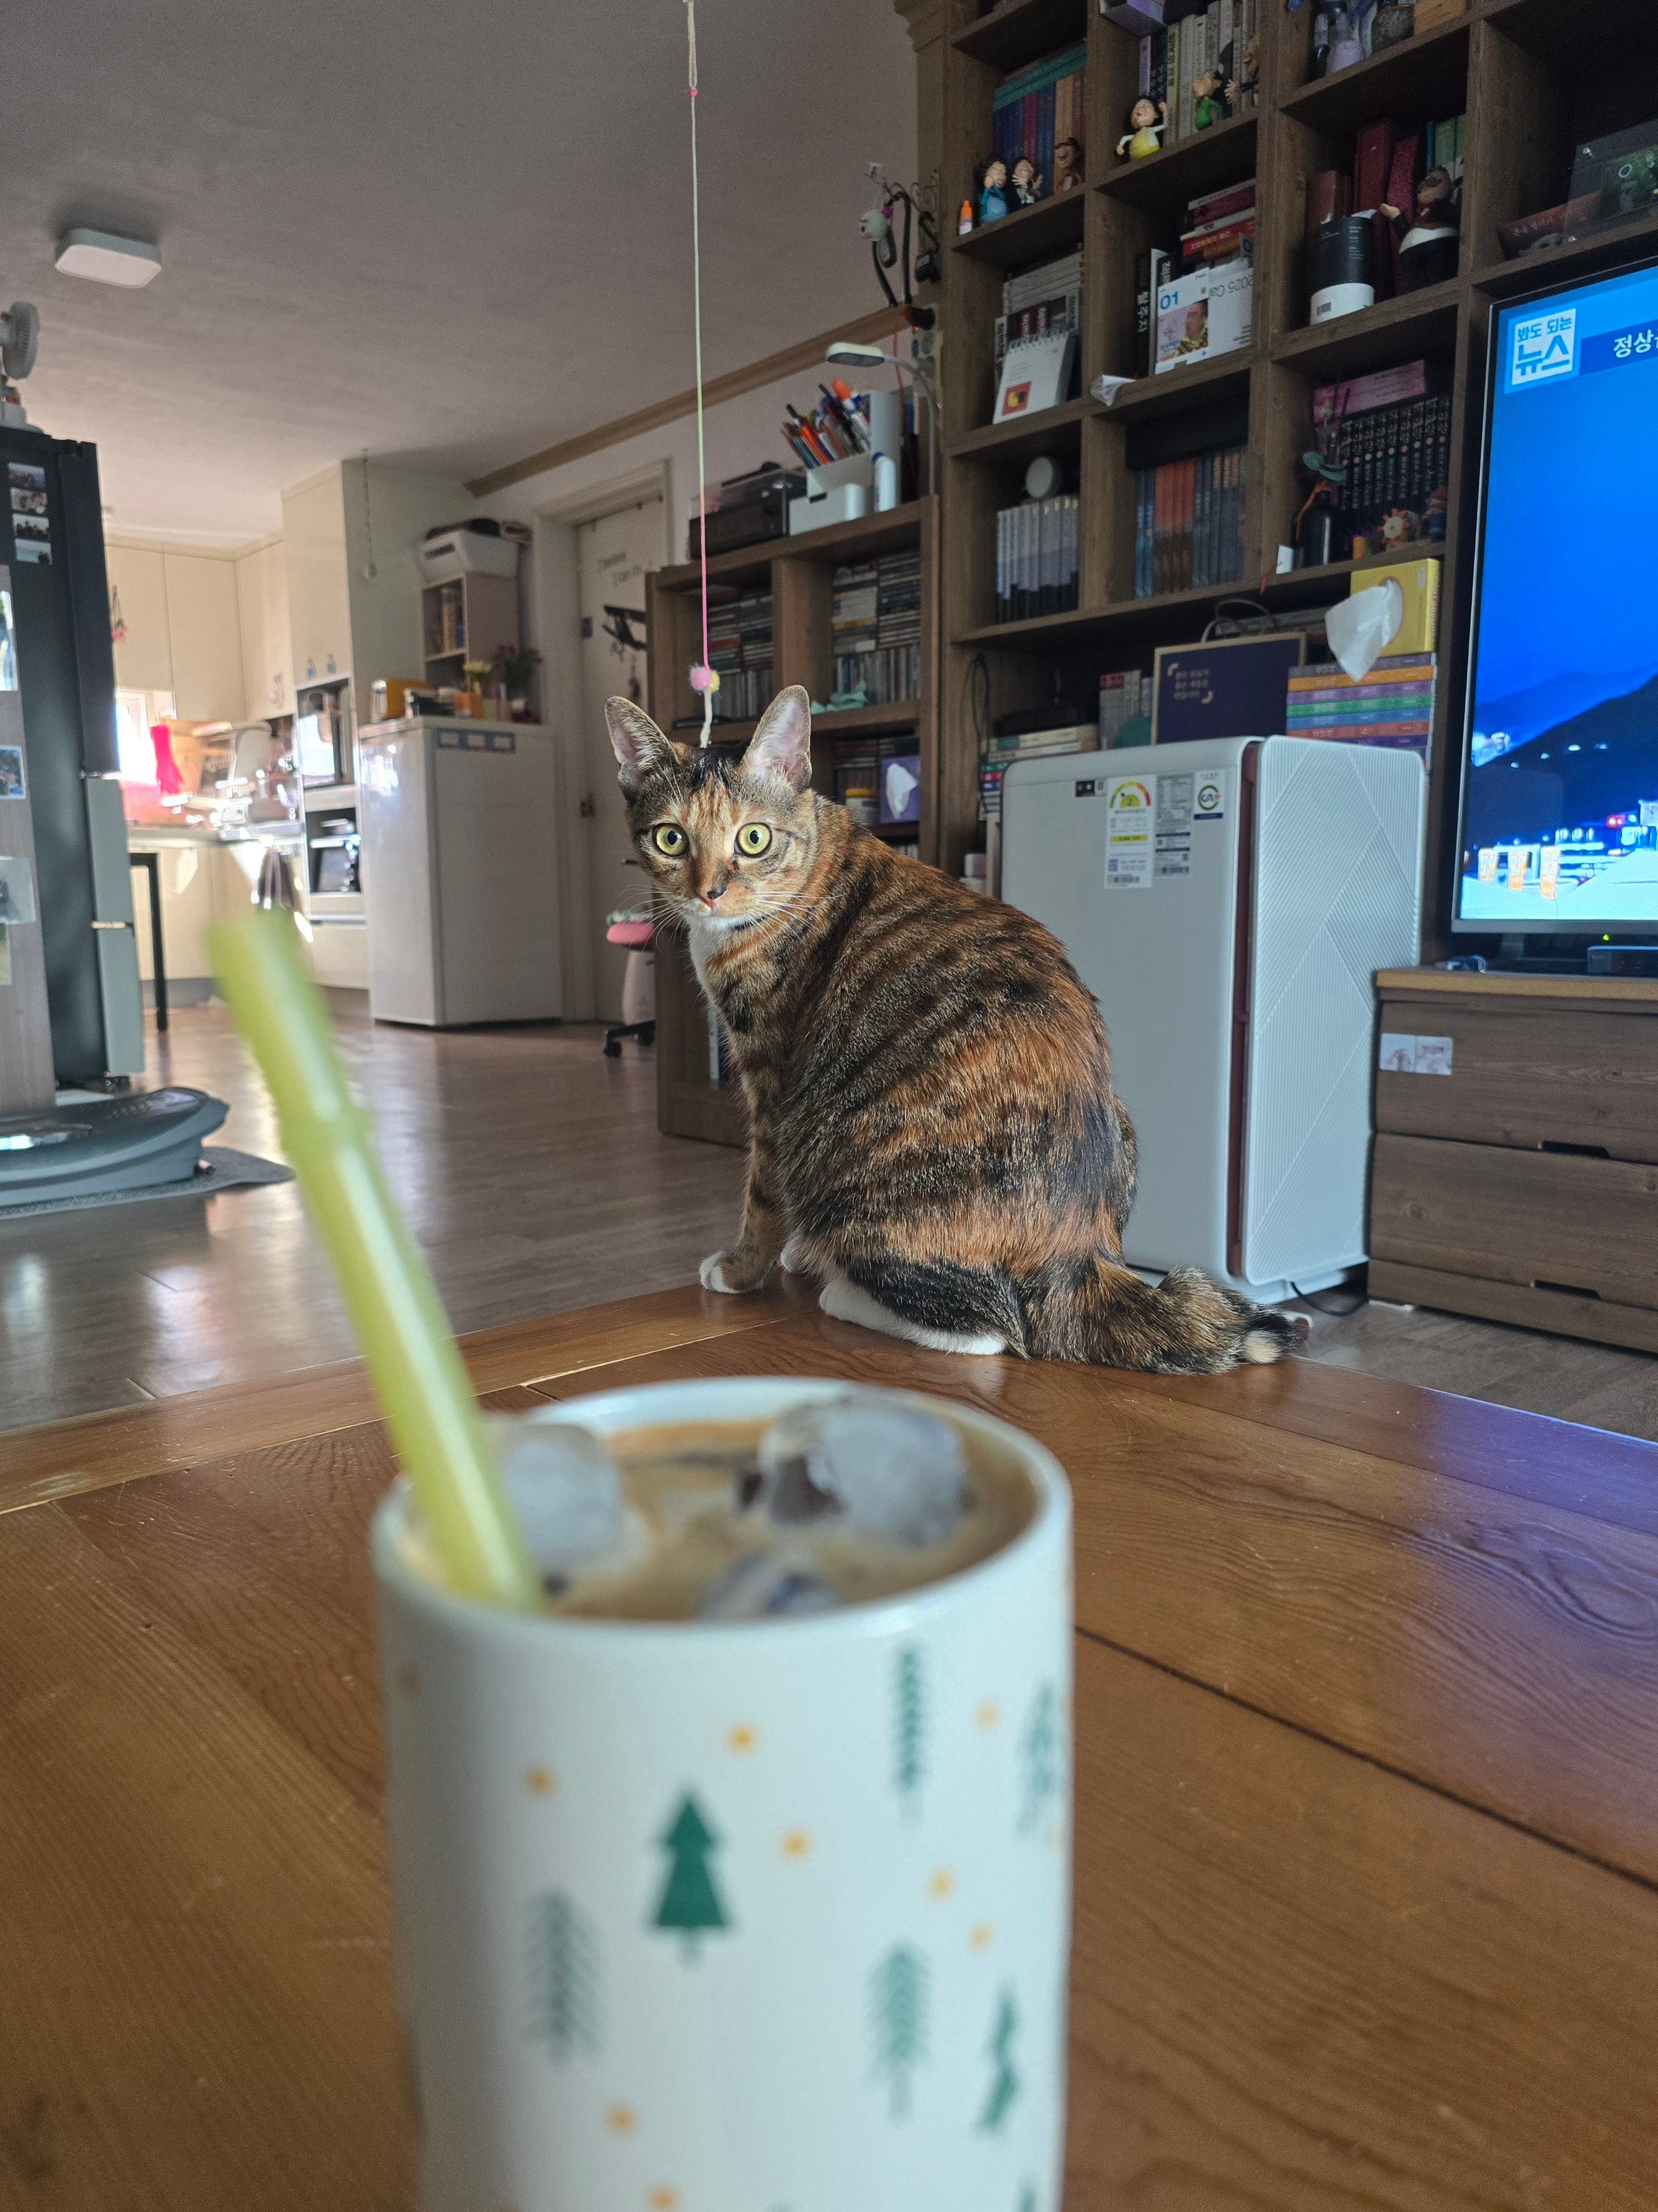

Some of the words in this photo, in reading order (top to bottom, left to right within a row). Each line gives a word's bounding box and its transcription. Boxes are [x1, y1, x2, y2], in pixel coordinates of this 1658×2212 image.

[1160, 291, 1179, 310] 01
[1517, 322, 1542, 342] 봐도
[1546, 317, 1572, 335] 되는
[1612, 328, 1658, 358] 정상
[1515, 335, 1570, 376] 뉴스
